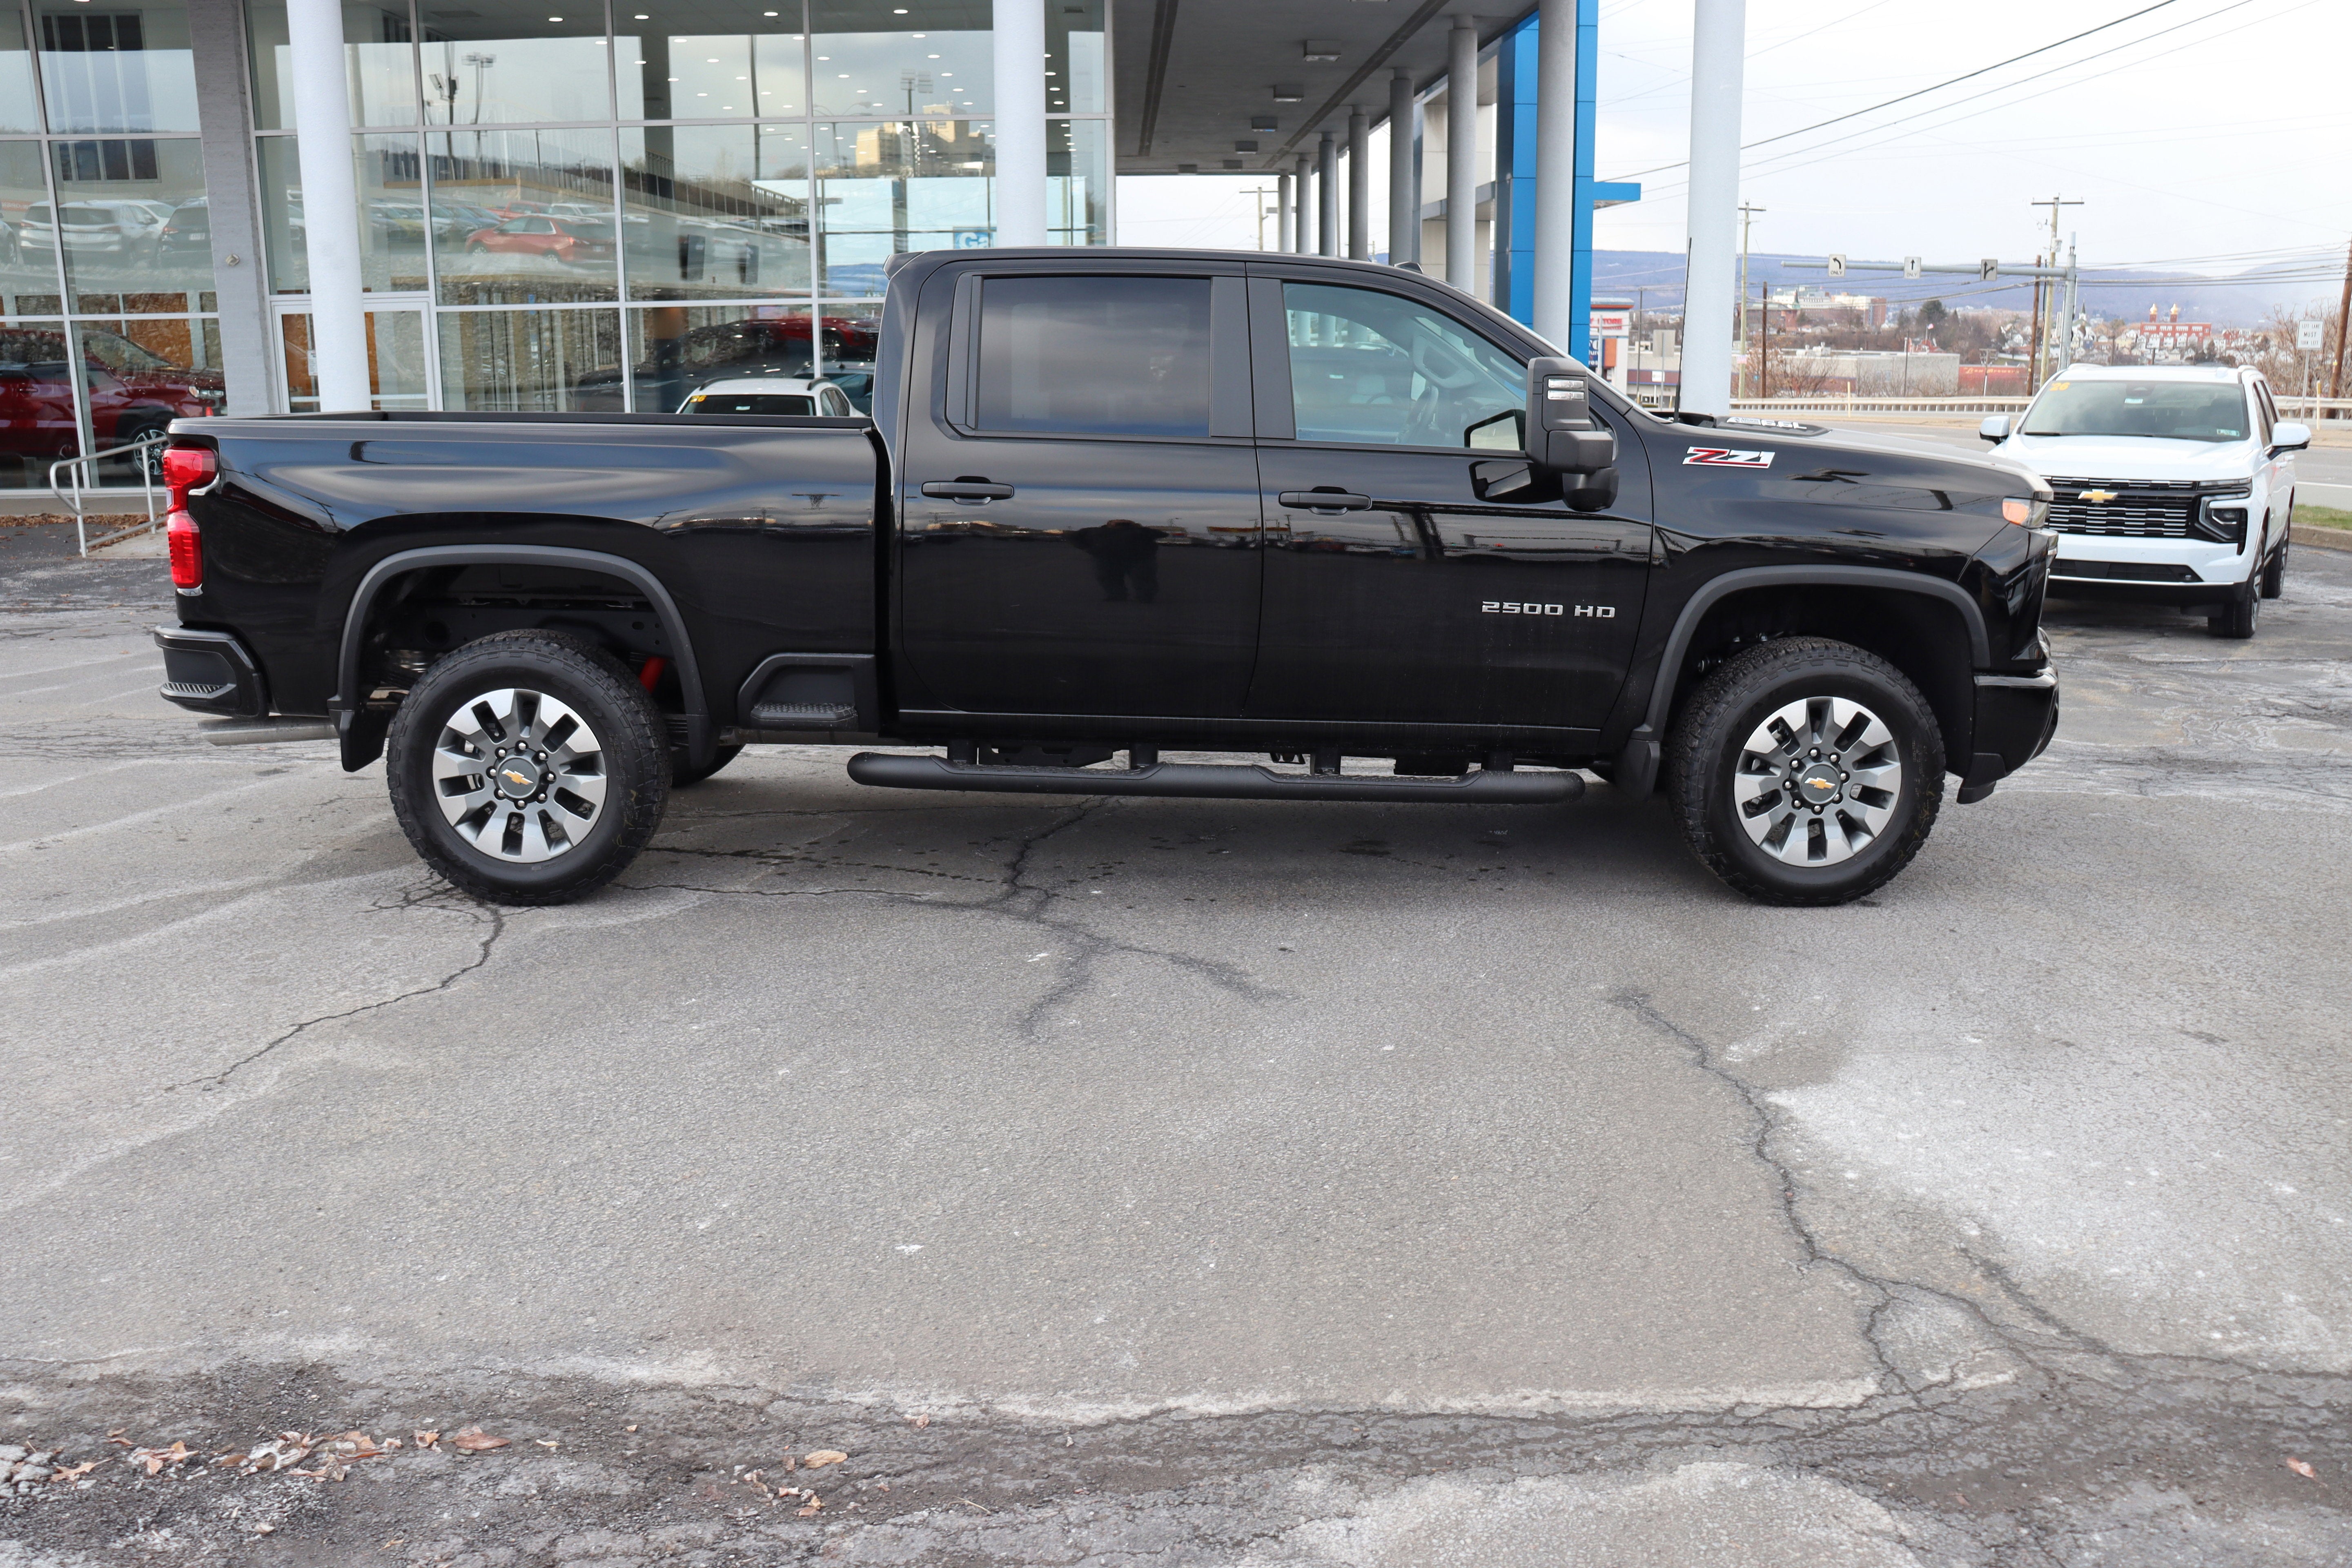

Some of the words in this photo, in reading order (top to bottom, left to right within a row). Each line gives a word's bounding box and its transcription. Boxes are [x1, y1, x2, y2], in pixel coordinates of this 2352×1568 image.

[1682, 446, 1775, 469] Z71
[1481, 601, 1564, 616] 2500
[1574, 605, 1615, 618] HD
